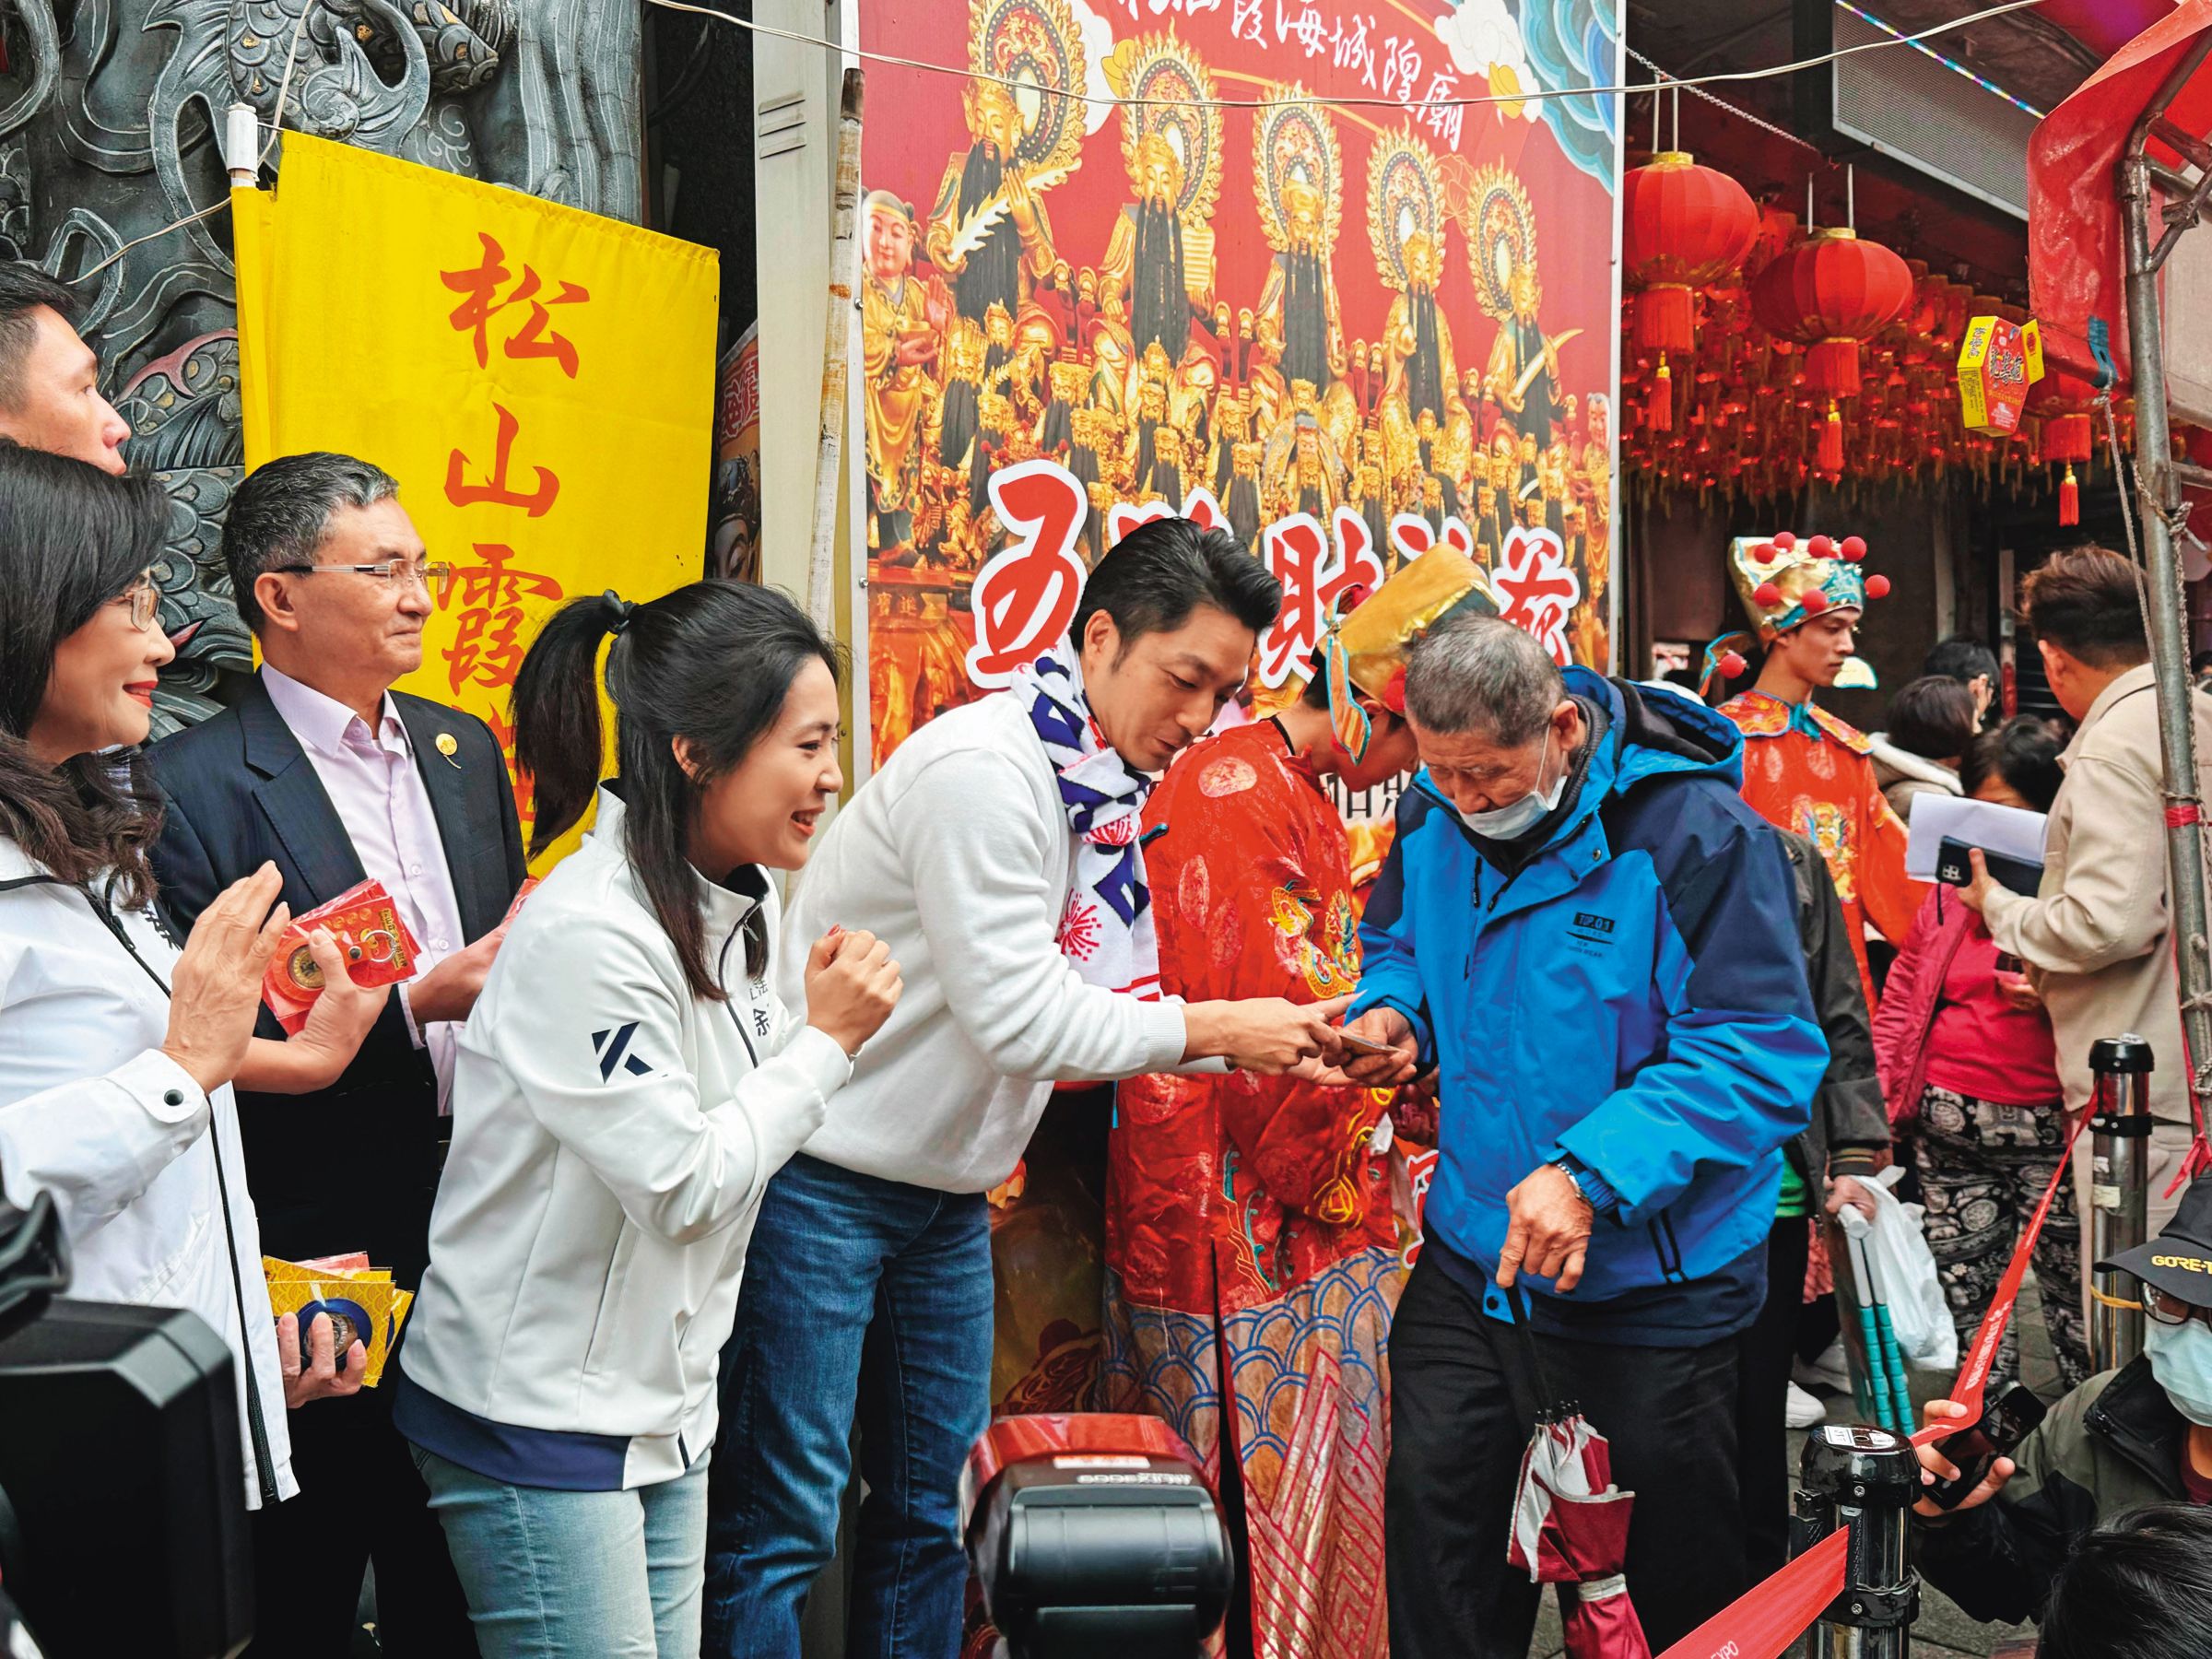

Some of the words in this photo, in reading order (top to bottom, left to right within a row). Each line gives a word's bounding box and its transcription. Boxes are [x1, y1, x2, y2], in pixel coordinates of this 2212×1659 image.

[1117, 0, 1465, 152] 霞海城隍廟
[437, 231, 591, 820] 松山霞
